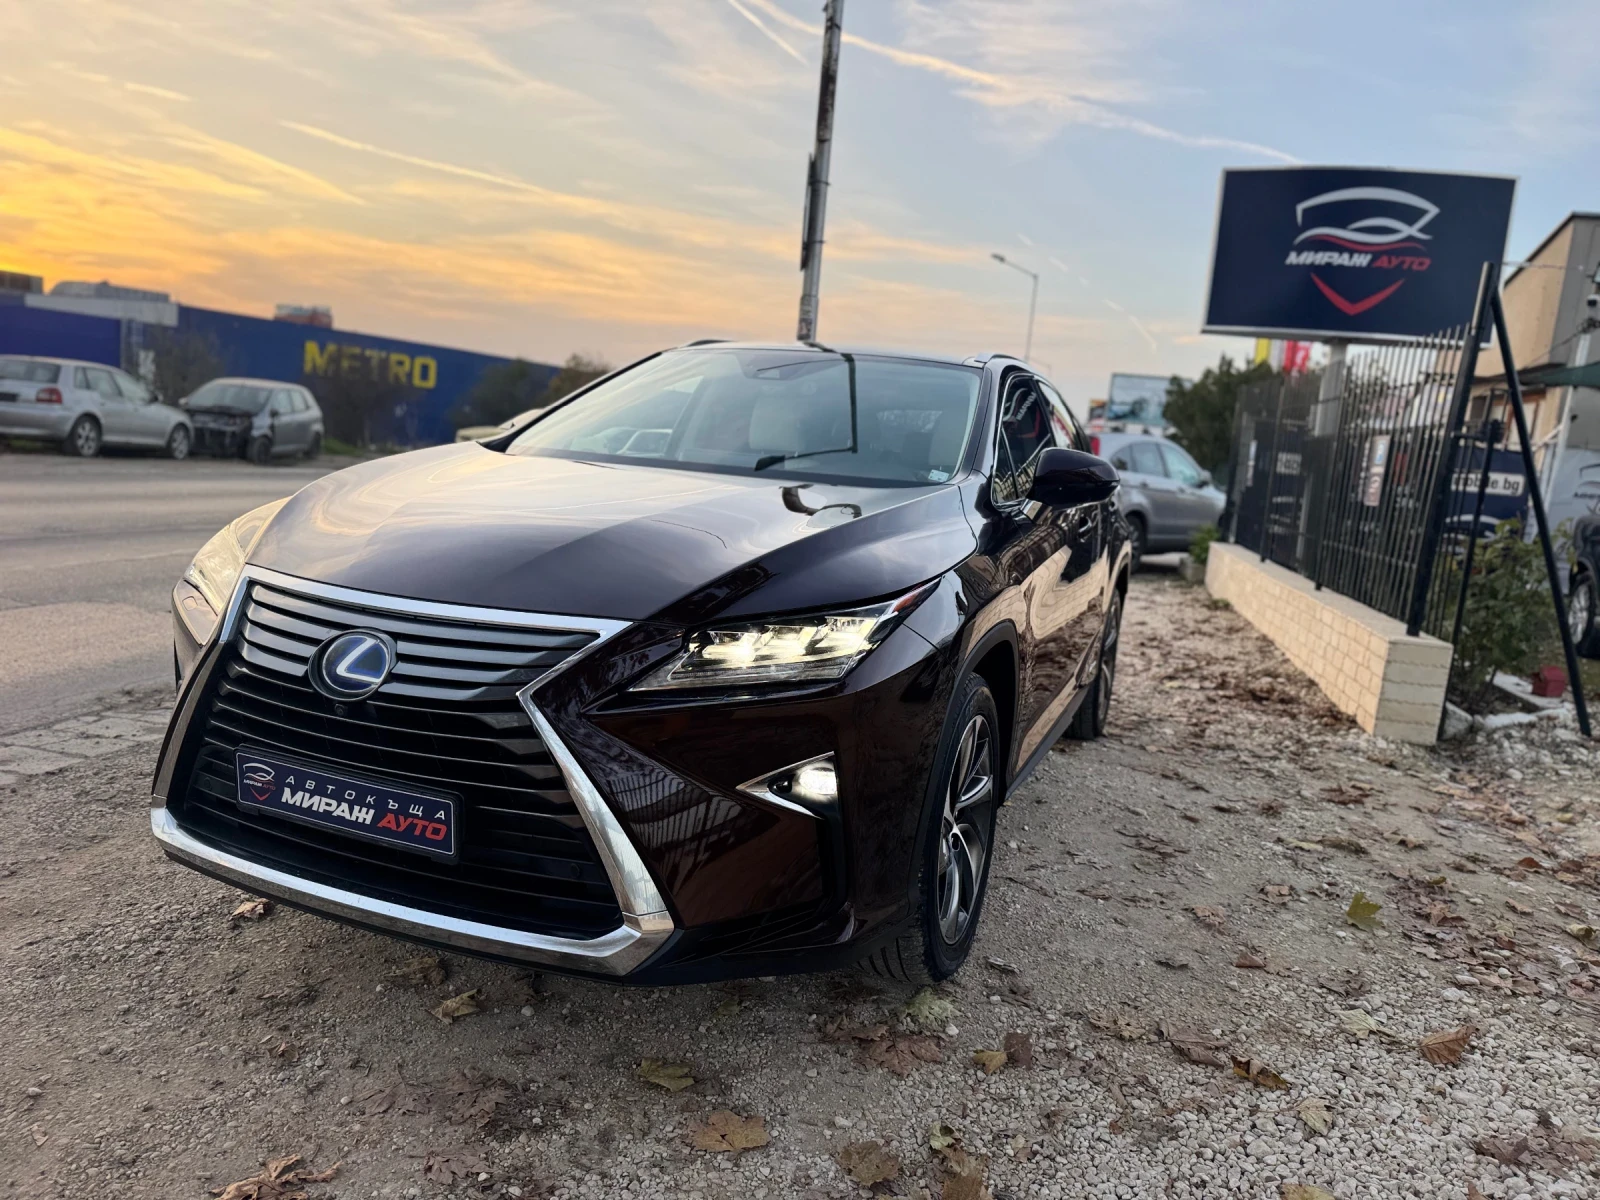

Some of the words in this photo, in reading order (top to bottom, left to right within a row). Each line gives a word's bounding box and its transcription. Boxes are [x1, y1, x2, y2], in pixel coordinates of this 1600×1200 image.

[1285, 251, 1372, 267] МИРАЖ
[1372, 255, 1431, 271] АУТО
[303, 340, 437, 389] METRO
[281, 787, 375, 825] МИРАЖ
[377, 813, 447, 841] АУТО
[285, 775, 446, 820] АВТОКЪЩА
